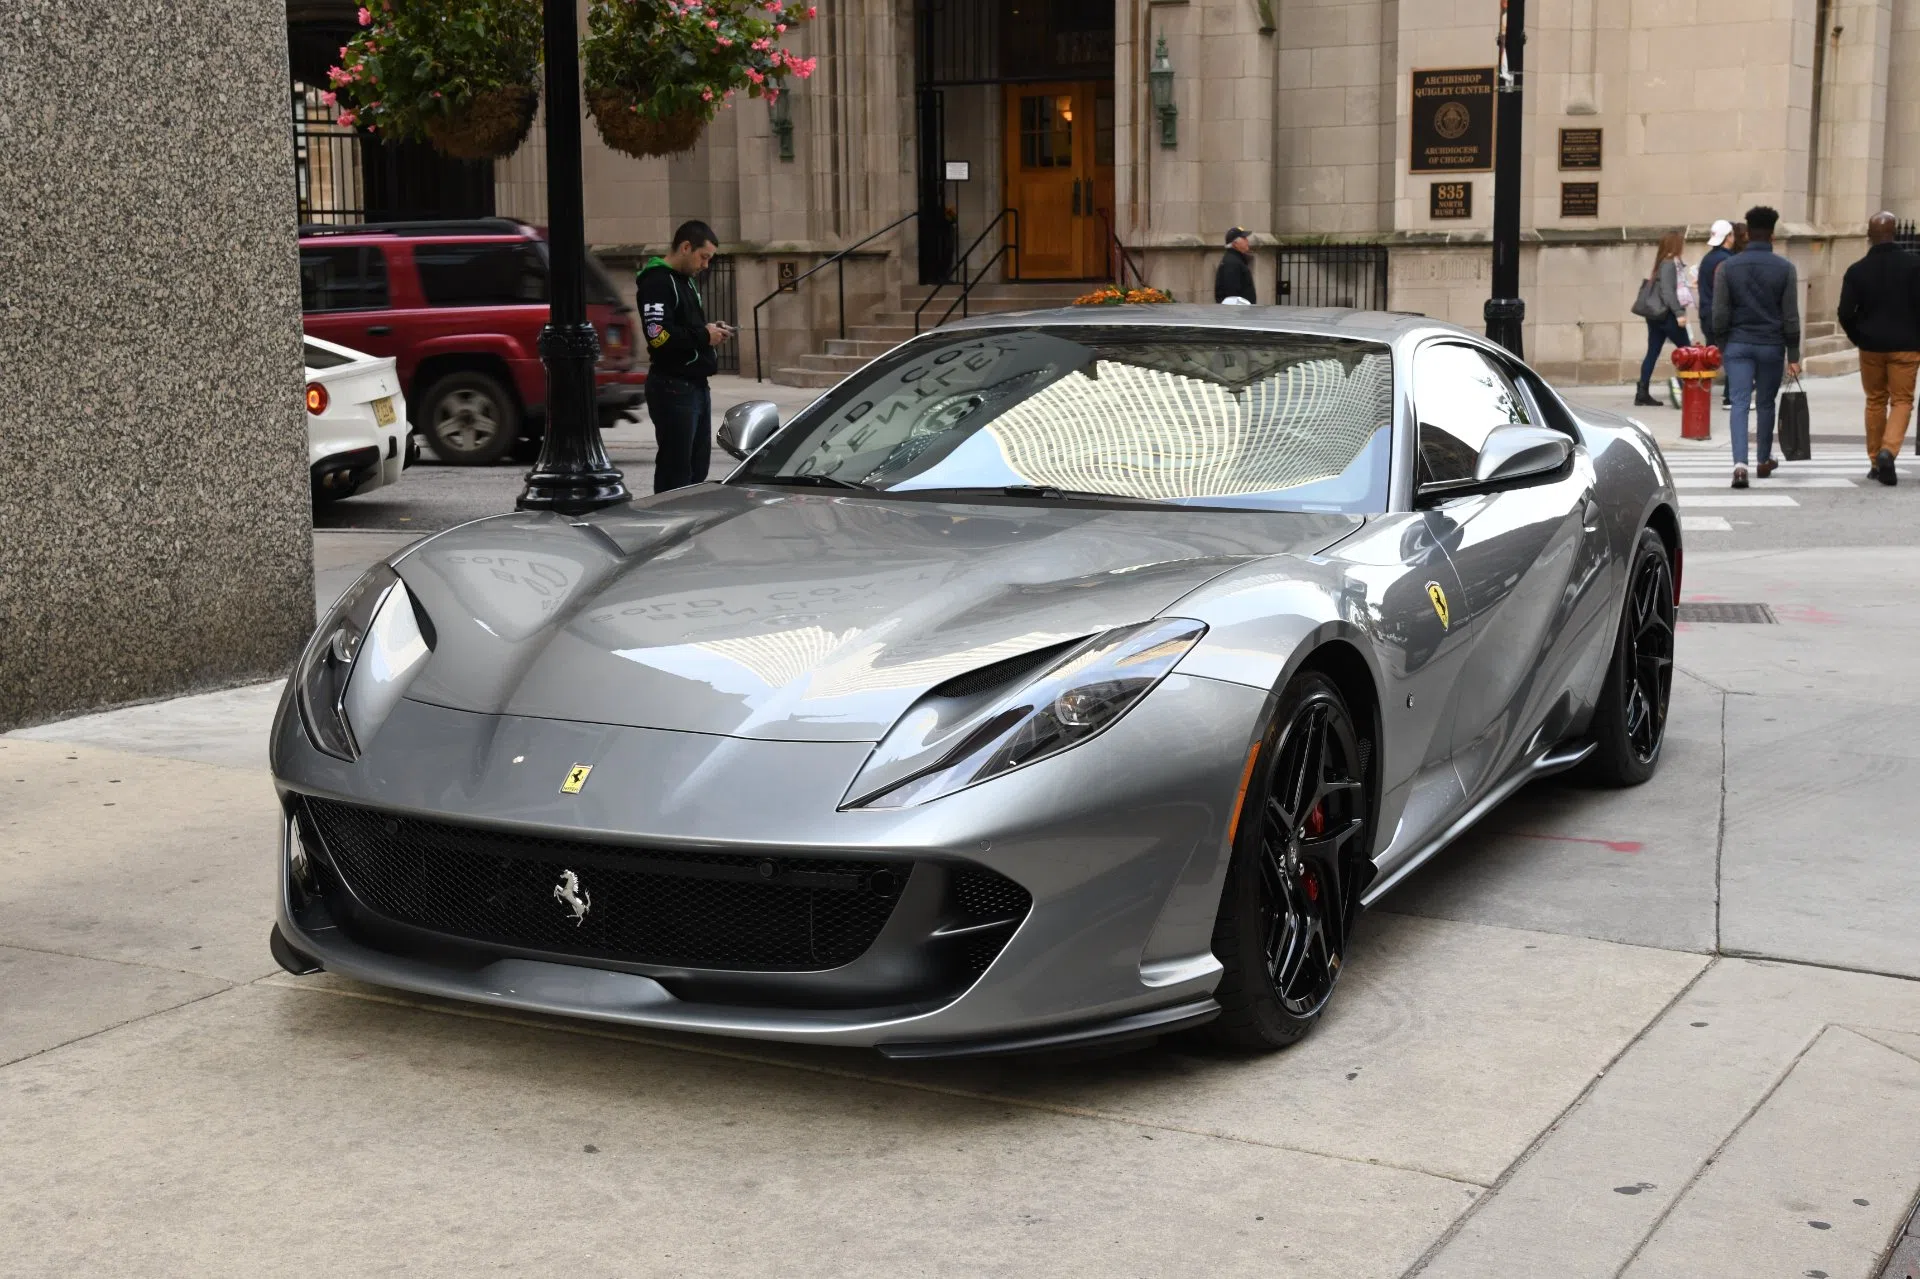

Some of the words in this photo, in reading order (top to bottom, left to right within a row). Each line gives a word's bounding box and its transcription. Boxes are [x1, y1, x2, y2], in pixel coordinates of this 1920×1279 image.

[1424, 74, 1482, 85] ARCHBISHOP
[1415, 87, 1454, 97] QUIGLEY
[1455, 85, 1490, 95] CENTER
[1424, 146, 1479, 155] ARCHDIOCESE
[1428, 157, 1439, 165] OF
[1440, 156, 1474, 164] CHICAGO
[1438, 184, 1464, 199] 835
[1439, 200, 1464, 208] NORTH
